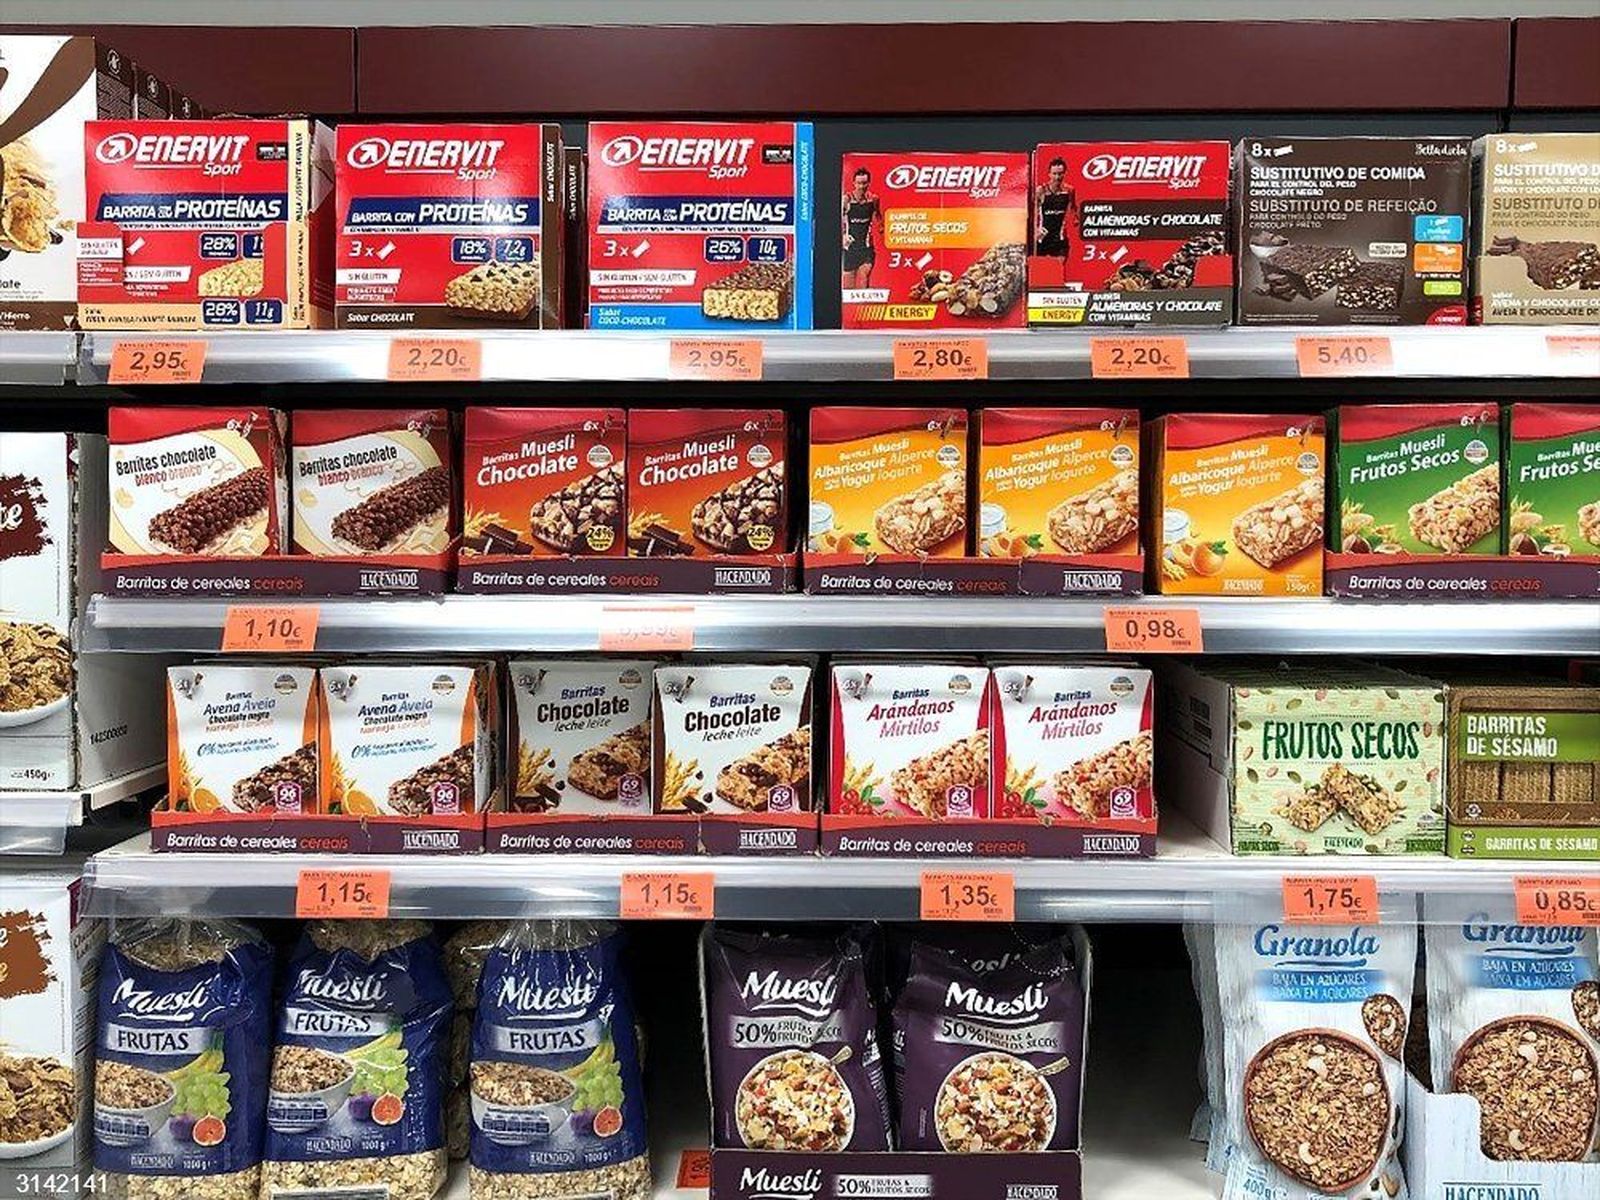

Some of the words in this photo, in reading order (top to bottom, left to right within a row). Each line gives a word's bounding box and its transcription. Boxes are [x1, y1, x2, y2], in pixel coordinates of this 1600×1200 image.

[135, 135, 250, 162] ENERVIT
[386, 139, 504, 167] ENERVIT
[641, 139, 754, 165] ENERVIT
[203, 162, 242, 176] Sport
[456, 167, 497, 181] Sport
[708, 165, 748, 179] Sport
[1115, 156, 1207, 178] ENERVIT
[1250, 167, 1344, 180] SUSTITUTIVO
[1348, 168, 1366, 179] DE
[1372, 167, 1425, 180] COMIDA
[1493, 164, 1587, 176] SUSTITUTIVO
[917, 166, 1007, 187] ENERVIT
[1168, 178, 1200, 189] Sport
[969, 187, 999, 198] Sport
[103, 206, 157, 219] BARRITA
[173, 197, 282, 220] PROTEÍNAS
[608, 209, 661, 221] BARRITA
[680, 200, 787, 222] PROTEÍNAS
[1250, 200, 1340, 212] SUBSTITUTO
[1344, 200, 1363, 212] DE
[1367, 197, 1437, 214] REFEIÇÃO
[1493, 198, 1584, 210] SUBSTITUTO
[352, 212, 393, 223] BARRITA
[395, 213, 415, 223] CON
[419, 201, 528, 223] PROTEÍNAS
[890, 223, 930, 232] FRUTOS
[933, 222, 969, 232] SECOS
[1083, 214, 1150, 226] ALMENDRAS
[1161, 214, 1223, 225] CHOCOLATE
[203, 236, 236, 250] 28%
[349, 241, 362, 256] 3
[460, 241, 487, 254] 18%
[603, 241, 616, 256] 3
[708, 241, 741, 254] 26%
[889, 252, 901, 267] 3
[1083, 246, 1094, 260] 3
[206, 302, 238, 316] 28%
[598, 308, 621, 317] Sabor
[890, 307, 930, 317] ENERGY
[1090, 301, 1154, 311] ALMENDRAS
[1165, 300, 1223, 311] CHOCOLATE
[1528, 308, 1584, 316] CHOCOLATE
[371, 313, 415, 322] CHOCOLATE
[598, 316, 667, 325] COCO-CHOCOLATE
[1042, 310, 1078, 320] ENERGY
[521, 434, 576, 458] Muesli
[683, 434, 736, 458] Muesli
[1366, 451, 1398, 463] Barritas
[1400, 434, 1446, 457] Muesli
[161, 446, 216, 468] chocolate
[300, 457, 341, 477] Barritas
[343, 445, 397, 468] chocolate
[476, 454, 578, 486] Chocolate
[640, 455, 738, 486] Chocolate
[1350, 460, 1407, 484] Frutos
[1411, 449, 1460, 471] Secos
[1520, 460, 1579, 483] Frutos
[841, 474, 876, 489] Yogur
[1013, 475, 1047, 490] Yogur
[1198, 481, 1235, 495] Yogur
[116, 575, 168, 589] Barritas
[170, 576, 189, 589] de
[192, 577, 250, 590] cereales
[360, 572, 418, 587] HACENDADO
[472, 571, 523, 585] Barritas
[526, 573, 545, 585] de
[548, 573, 607, 586] cereales
[715, 570, 771, 585] HACENDADO
[820, 574, 871, 588] Barritas
[873, 575, 892, 589] de
[895, 576, 954, 591] cereales
[1063, 572, 1122, 588] HACENDADO
[1349, 575, 1402, 590] Barritas
[1405, 576, 1424, 590] de
[1427, 577, 1488, 591] cereales
[561, 686, 606, 699] Barritas
[709, 692, 757, 708] Barritas
[892, 688, 929, 700] Barritas
[1054, 691, 1091, 702] Barritas
[203, 703, 240, 716] Avena
[358, 704, 397, 717] Avena
[400, 699, 433, 712] Aveia
[537, 697, 630, 723] Chocolate
[867, 700, 955, 721] Arándanos
[1029, 702, 1117, 723] Arándanos
[685, 704, 782, 732] Chocolate
[1467, 716, 1546, 735] BARRITAS
[555, 721, 585, 732] leche
[880, 718, 940, 738] Mirtilos
[1041, 720, 1103, 740] Mirtilos
[702, 731, 735, 741] leche
[1262, 720, 1344, 760] FRUTOS
[1351, 721, 1420, 759] SECOS
[1467, 737, 1486, 755] DE
[1492, 734, 1558, 757] SÉSAMO
[622, 780, 638, 792] 69
[280, 788, 296, 800] 96
[437, 789, 454, 800] 96
[772, 791, 790, 803] 69
[951, 791, 968, 802] 69
[1114, 792, 1131, 803] 69
[167, 833, 217, 847] Barritas
[219, 834, 237, 847] de
[240, 835, 297, 848] cereales
[403, 832, 460, 847] HACENDADO
[500, 834, 550, 848] Barritas
[553, 834, 572, 848] de
[575, 835, 632, 849] cereales
[740, 831, 796, 846] HACENDADO
[839, 837, 890, 851] Barritas
[893, 837, 912, 851] de
[915, 838, 974, 853] cereales
[1083, 837, 1140, 851] HACENDADO
[1539, 839, 1553, 849] DE
[1556, 836, 1598, 850] SÉSAMO
[1253, 924, 1380, 957] Granola
[1483, 960, 1509, 972] BAJA
[1511, 960, 1525, 972] EN
[1273, 973, 1298, 985] BAJA
[1301, 974, 1314, 985] EN
[945, 981, 1049, 1016] Muesli
[1303, 987, 1318, 998] EM
[295, 1013, 372, 1033] FRUTAS
[942, 1018, 984, 1042] 50%
[509, 1029, 586, 1050] FRUTAS
[734, 1021, 777, 1043] 50%
[118, 1030, 190, 1051] FRUTAS
[1026, 1038, 1059, 1048] SECOS
[739, 1167, 822, 1192] Muesli
[838, 1178, 872, 1194] 50%
[1445, 1187, 1539, 1200] HACENDADO
